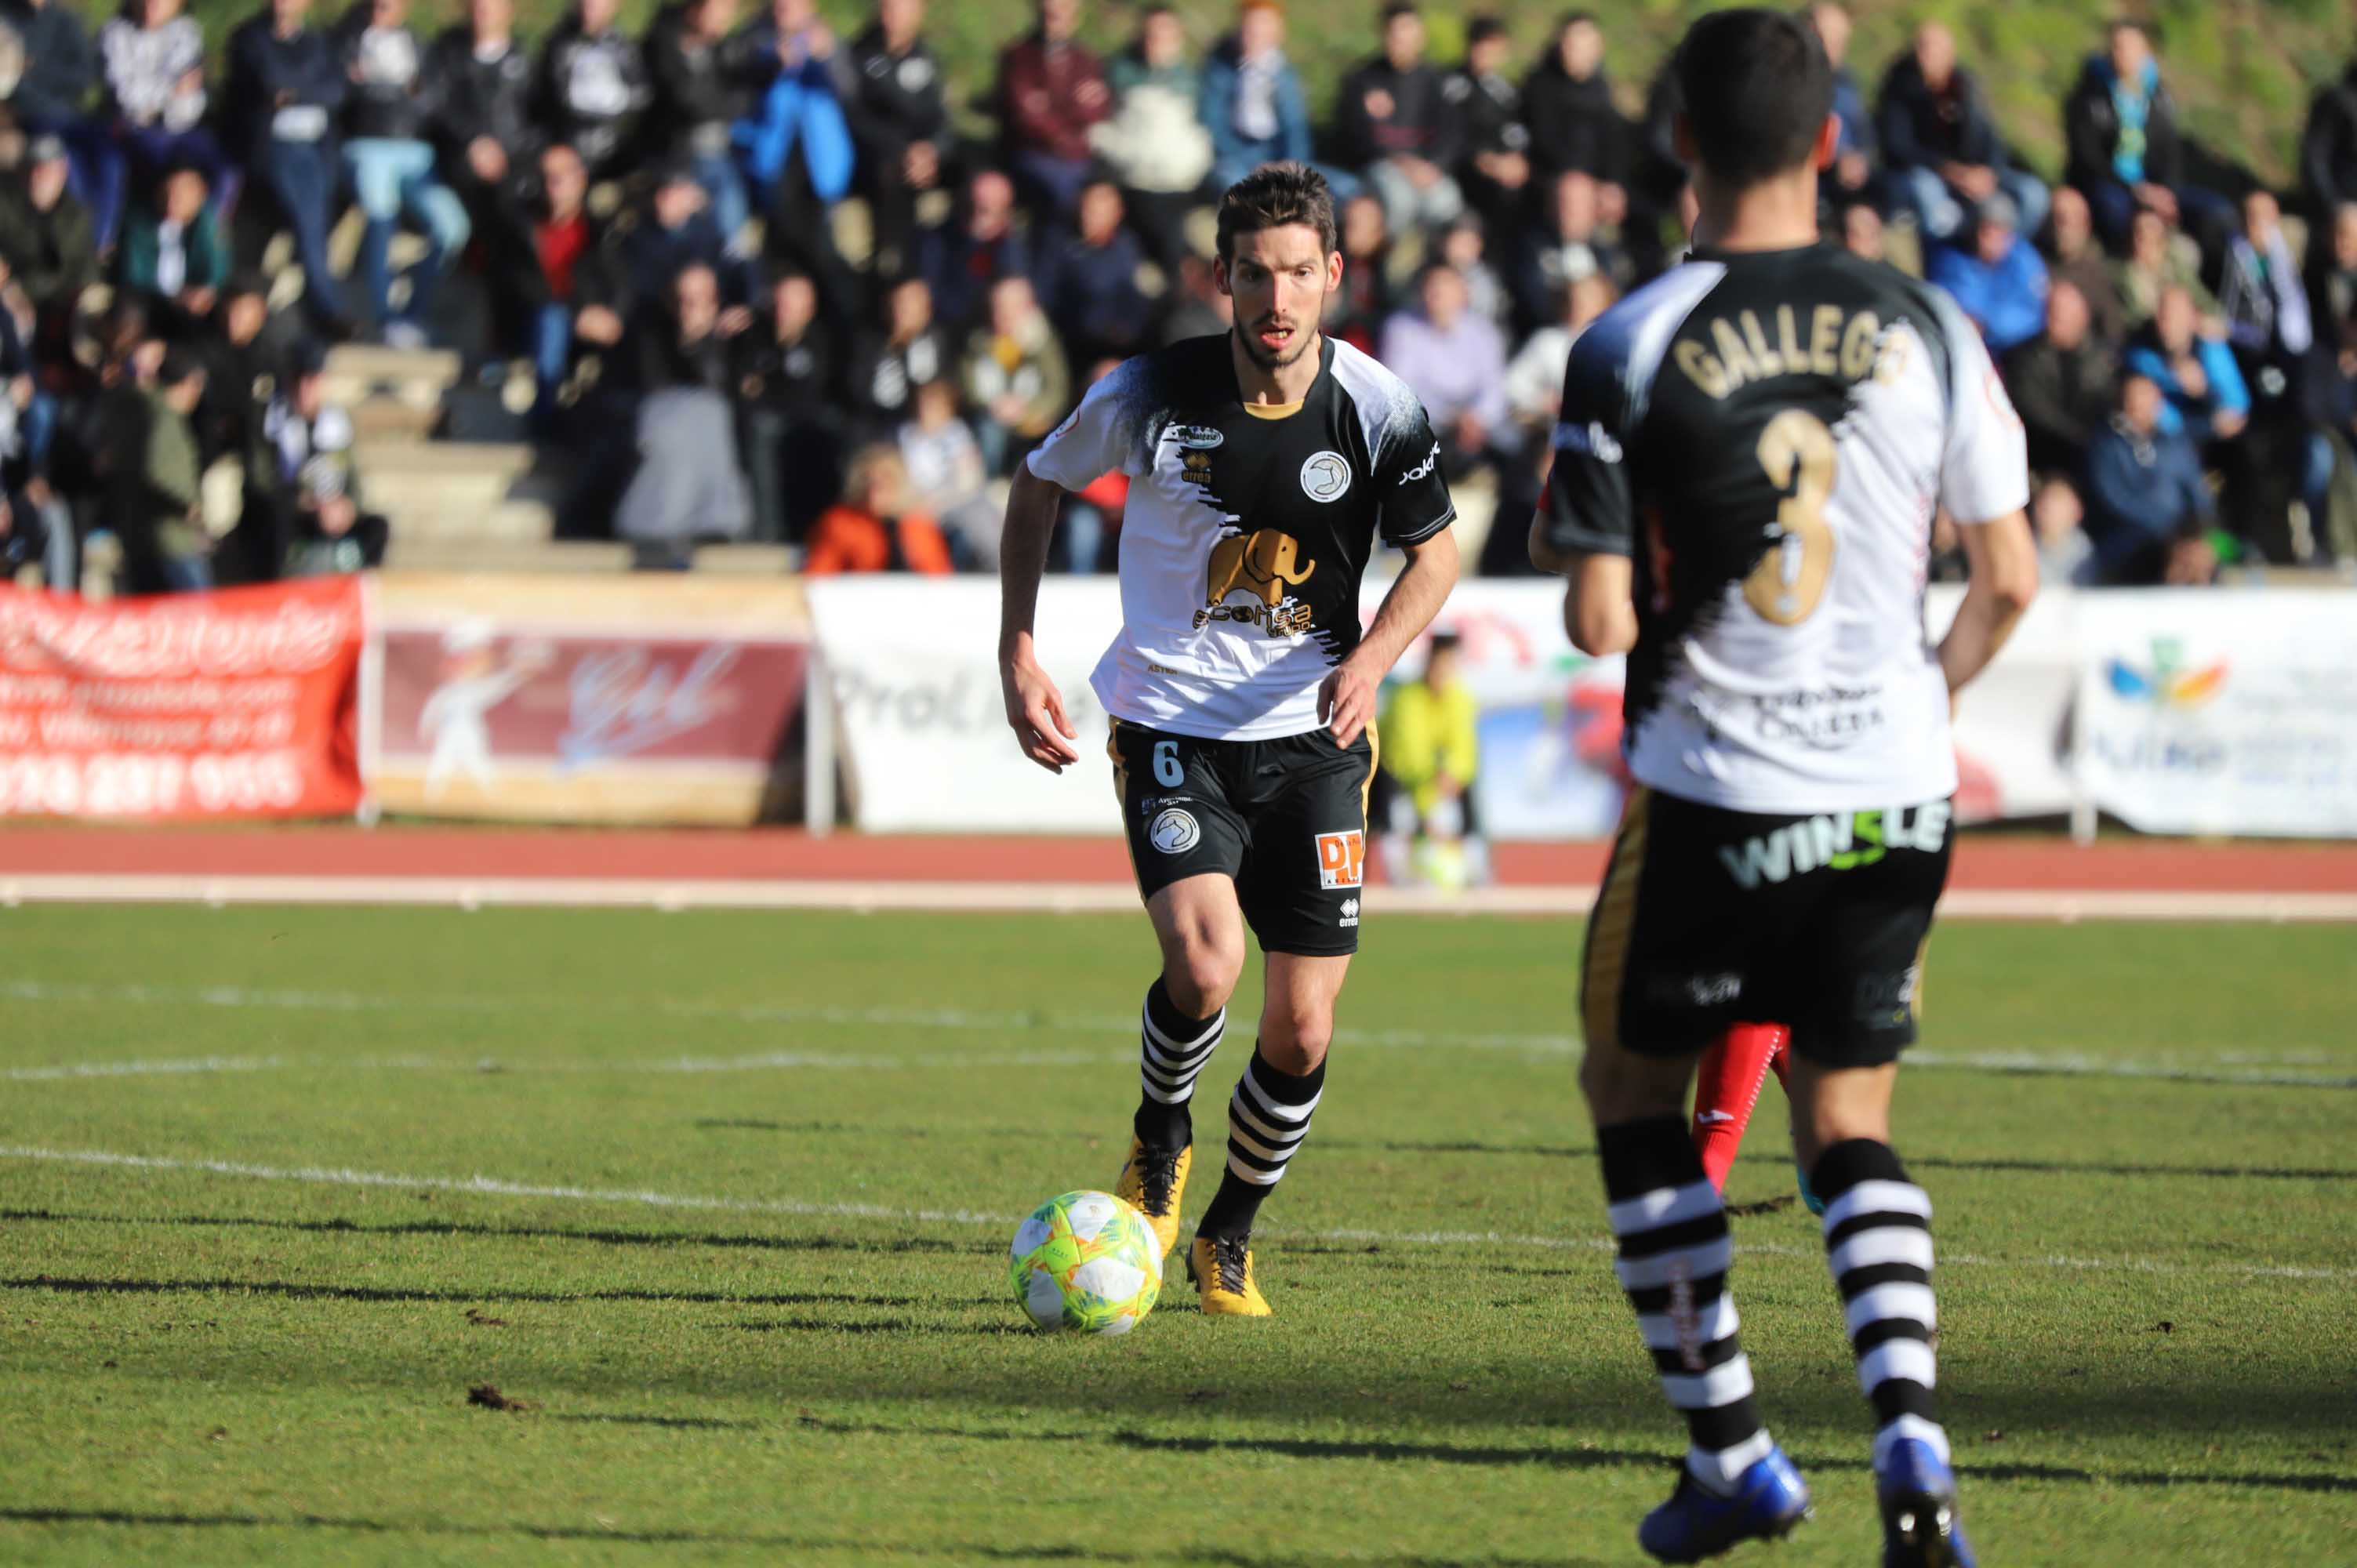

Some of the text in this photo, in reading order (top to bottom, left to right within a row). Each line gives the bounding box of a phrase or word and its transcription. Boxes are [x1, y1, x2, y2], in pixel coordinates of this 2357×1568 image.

[1741, 408, 1836, 626] 3
[1153, 740, 1184, 787] 6
[1719, 801, 1951, 888] WINSLE
